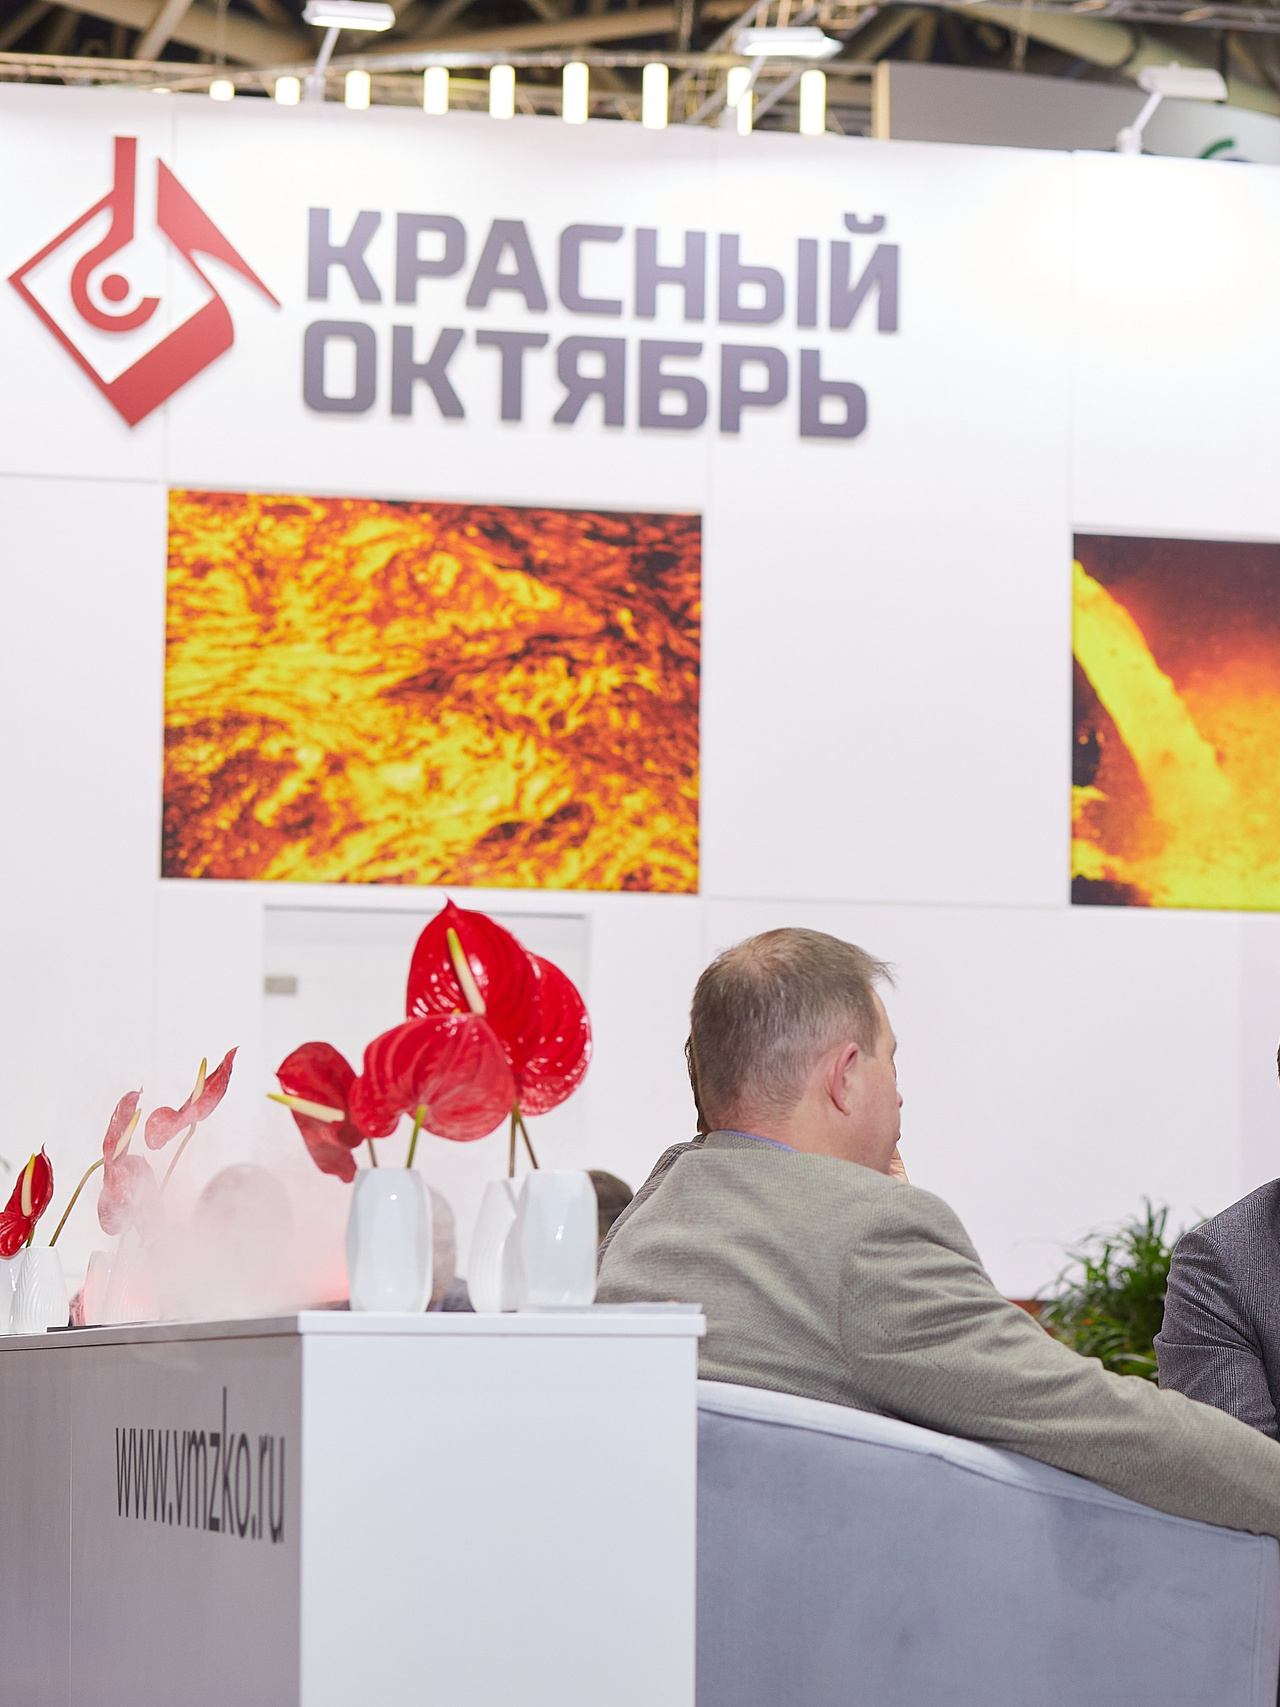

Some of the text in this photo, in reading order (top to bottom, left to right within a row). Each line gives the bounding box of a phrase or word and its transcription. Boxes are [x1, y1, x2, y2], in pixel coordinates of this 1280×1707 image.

[306, 207, 901, 334] КРАСНЫЙ
[302, 319, 869, 440] ОКТЯБРЬ
[115, 1386, 286, 1545] www.vmzko.ru
